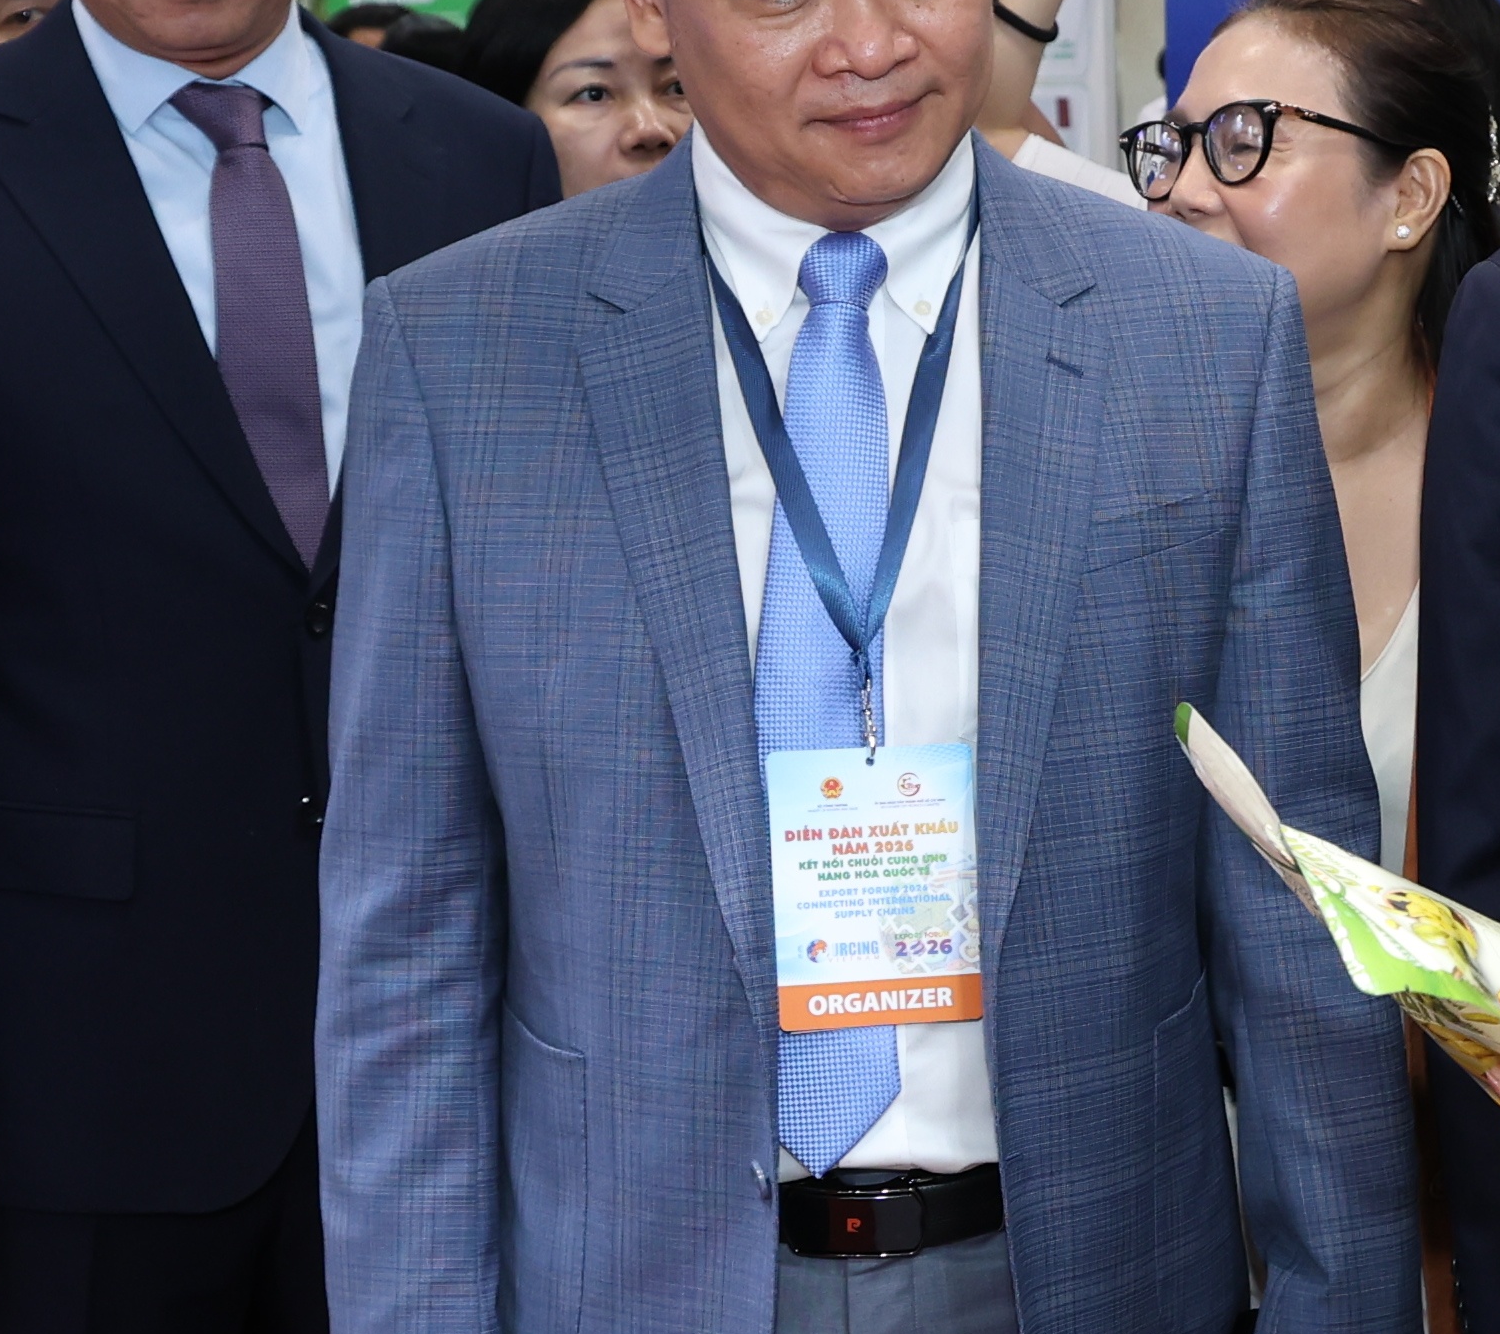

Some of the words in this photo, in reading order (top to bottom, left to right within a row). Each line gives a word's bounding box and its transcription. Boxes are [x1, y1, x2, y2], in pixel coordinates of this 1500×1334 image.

[868, 820, 909, 837] XUẤT
[875, 840, 915, 854] 2026
[887, 854, 919, 866] CUNG
[819, 887, 859, 898] EXPORT
[863, 885, 900, 896] FORUM
[903, 884, 929, 894] 2026
[797, 898, 864, 911] CONNECTING
[869, 893, 953, 907] INTERNATIONAL
[835, 909, 873, 919] SUPPLY
[877, 906, 916, 917] CHAINS
[808, 986, 954, 1016] ORGANIZER
